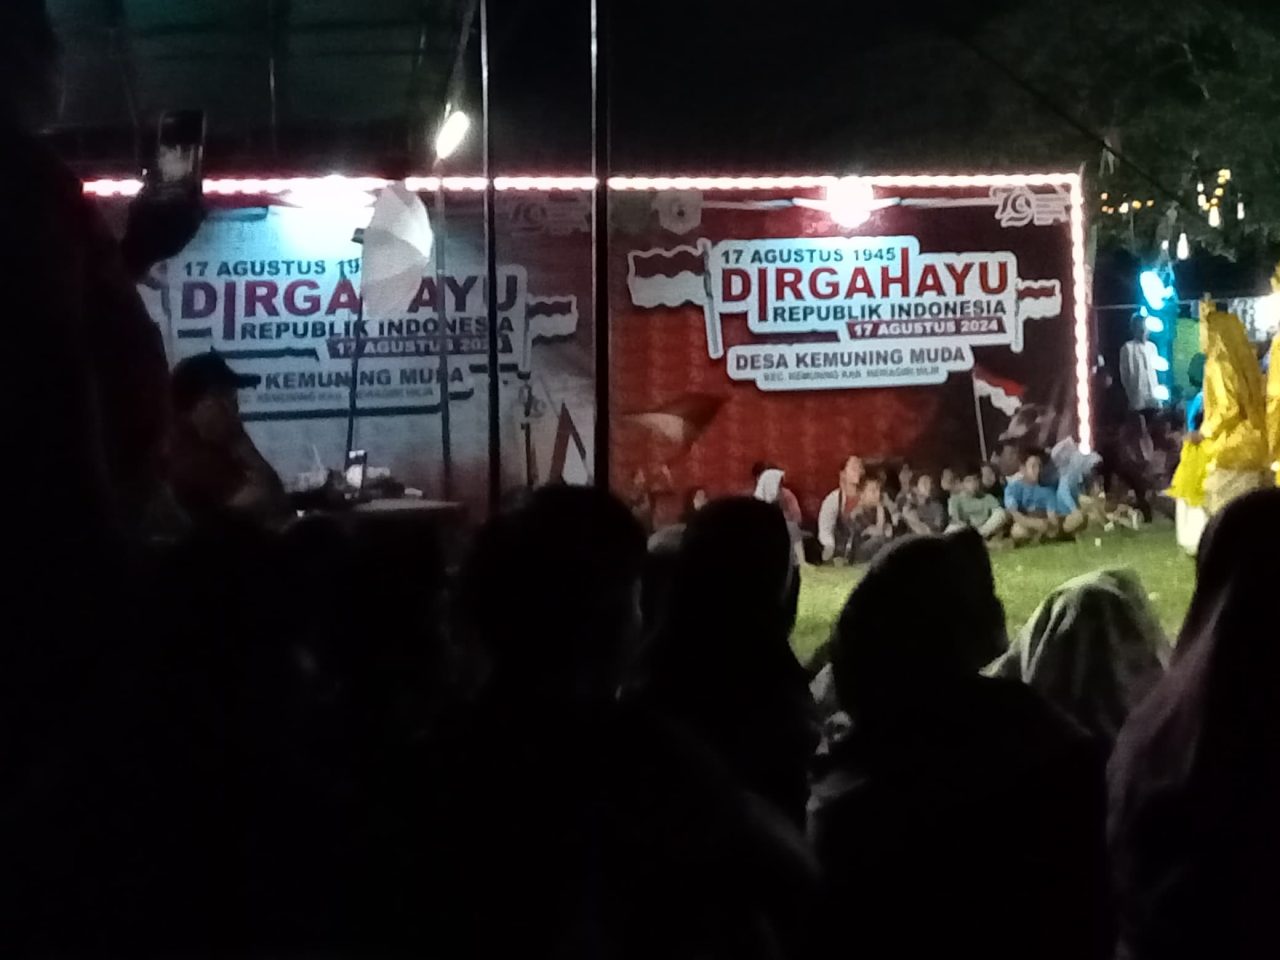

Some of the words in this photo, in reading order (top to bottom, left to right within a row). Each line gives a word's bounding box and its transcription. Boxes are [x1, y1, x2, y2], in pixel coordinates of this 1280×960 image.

[721, 249, 743, 264] 17
[751, 248, 844, 264] AGUSTUS
[854, 247, 896, 261] 1945
[185, 261, 208, 276] 17
[217, 259, 326, 276] AGUSTUS
[337, 257, 360, 278] 19
[722, 247, 1008, 322] DIRGAHAYU
[181, 274, 518, 340] DIRGAAYU
[773, 303, 882, 322] REPUBLIK
[890, 299, 1007, 319] INDONESIA
[241, 319, 369, 340] REPUBLIK
[379, 315, 514, 337] INDONESA
[854, 323, 873, 337] 17
[877, 320, 956, 336] AGUSTUS
[960, 318, 999, 333] 2024
[736, 352, 789, 371] DESA
[796, 348, 903, 369] KEMUNING
[909, 345, 966, 364] MUDA
[265, 370, 391, 389] KEMUNNG
